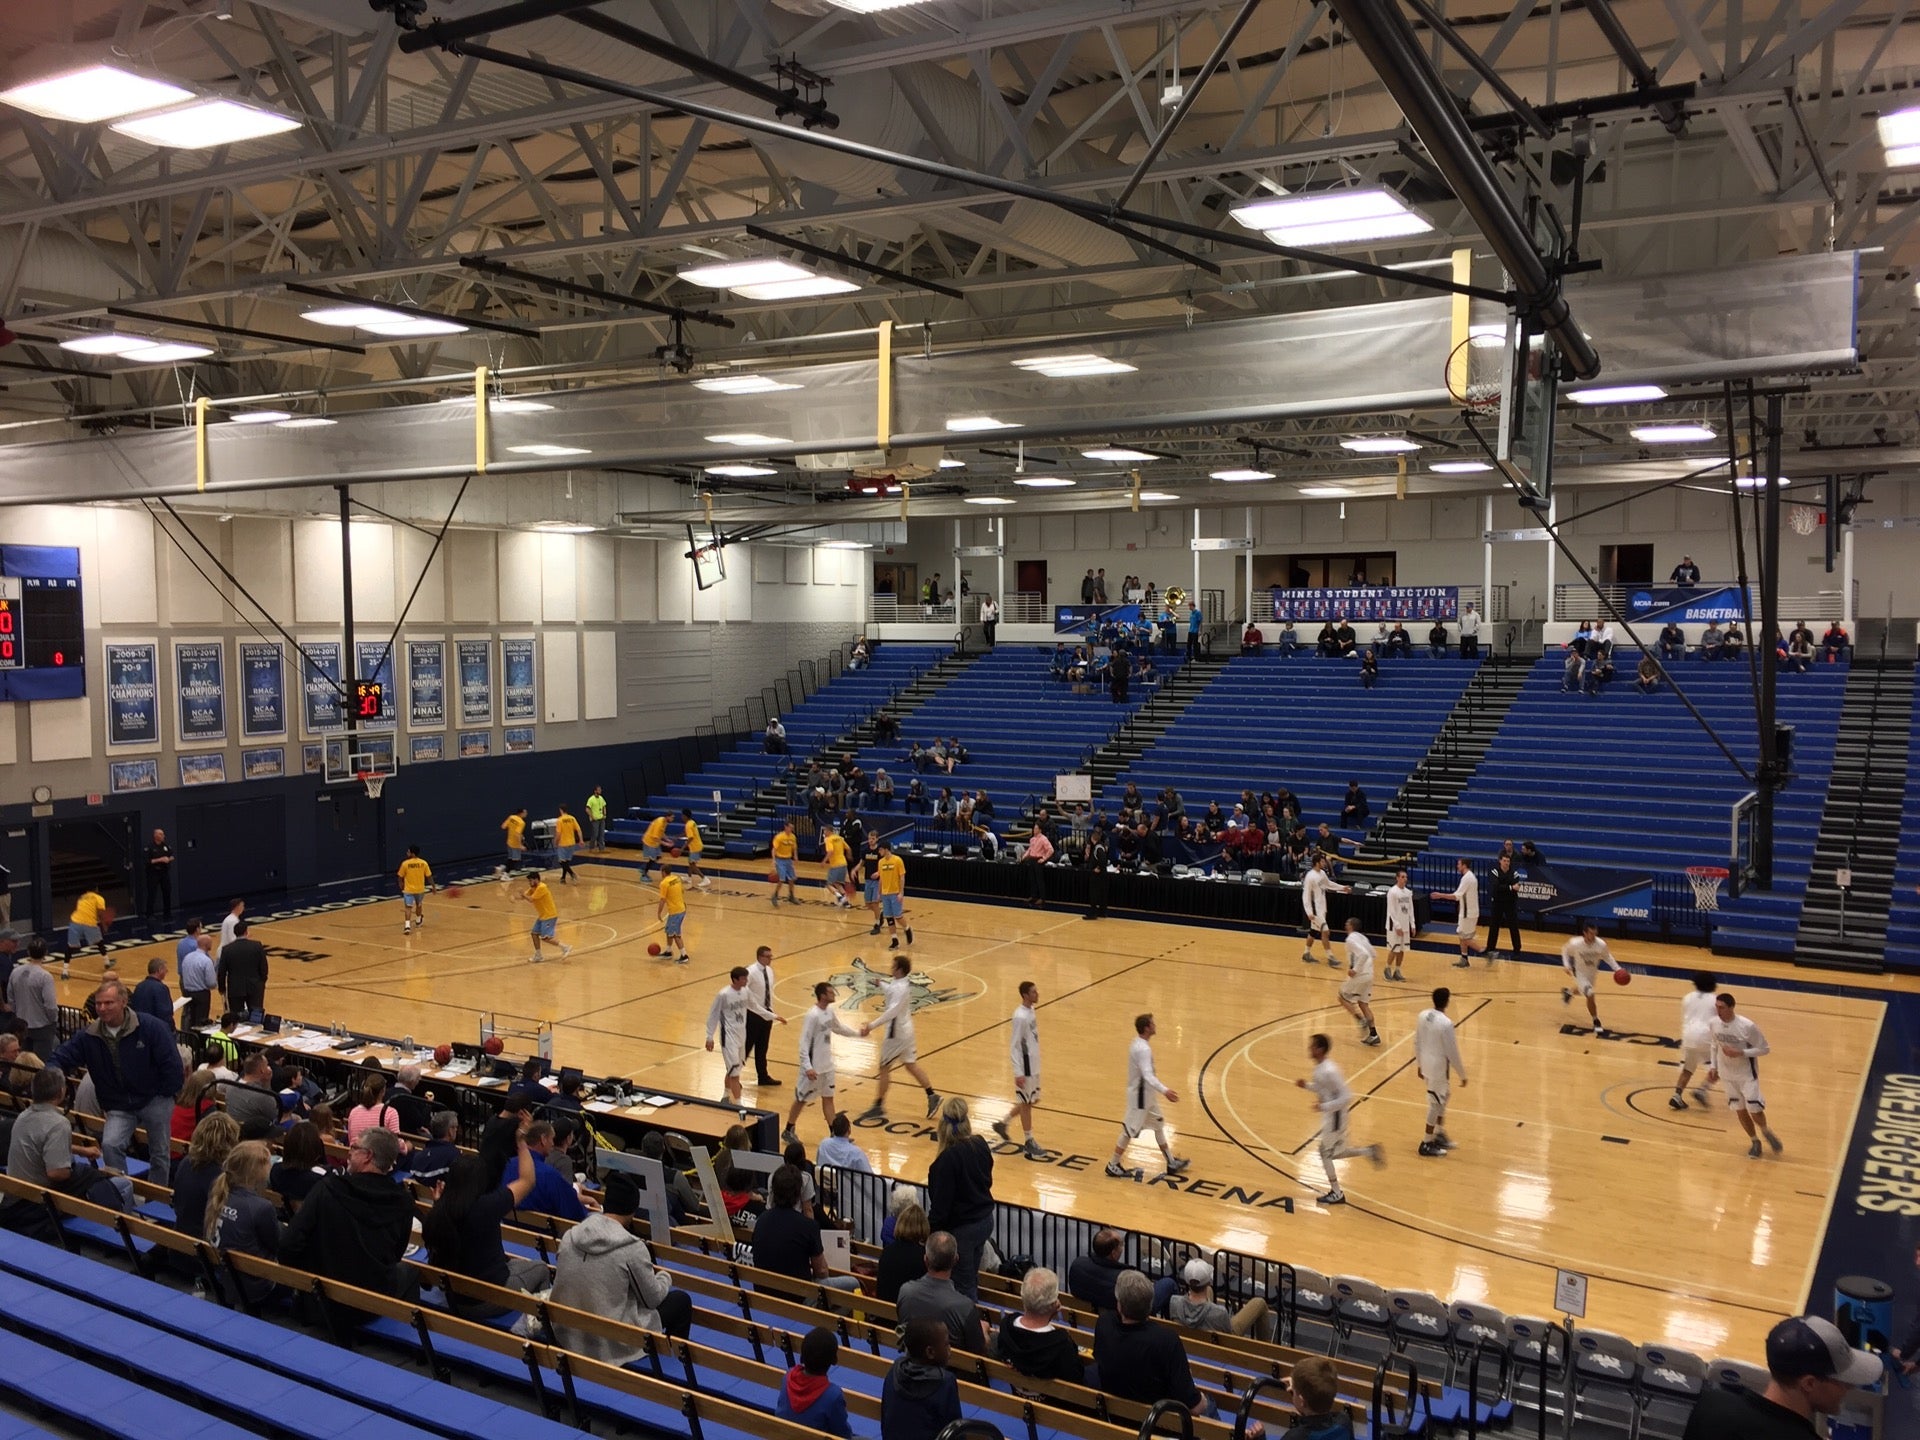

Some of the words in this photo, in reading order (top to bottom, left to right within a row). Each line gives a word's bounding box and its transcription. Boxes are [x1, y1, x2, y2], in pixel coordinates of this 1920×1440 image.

[1281, 590, 1321, 599] MINES
[1326, 589, 1384, 599] STUDENT
[1390, 588, 1447, 598] SECTION
[1684, 607, 1745, 620] BASKETBAL
[111, 688, 153, 699] CHAMPIONS
[181, 686, 221, 697] CHAMPIONS
[191, 709, 214, 717] NCAA
[254, 705, 275, 713] NCAA
[314, 704, 334, 712] NCAA
[413, 706, 442, 715] FINALS
[121, 712, 145, 720] NCAA
[1518, 884, 1558, 897] ASKETBALL
[1612, 906, 1649, 918] #NCAAD2
[838, 1110, 1098, 1171] OCKDGE
